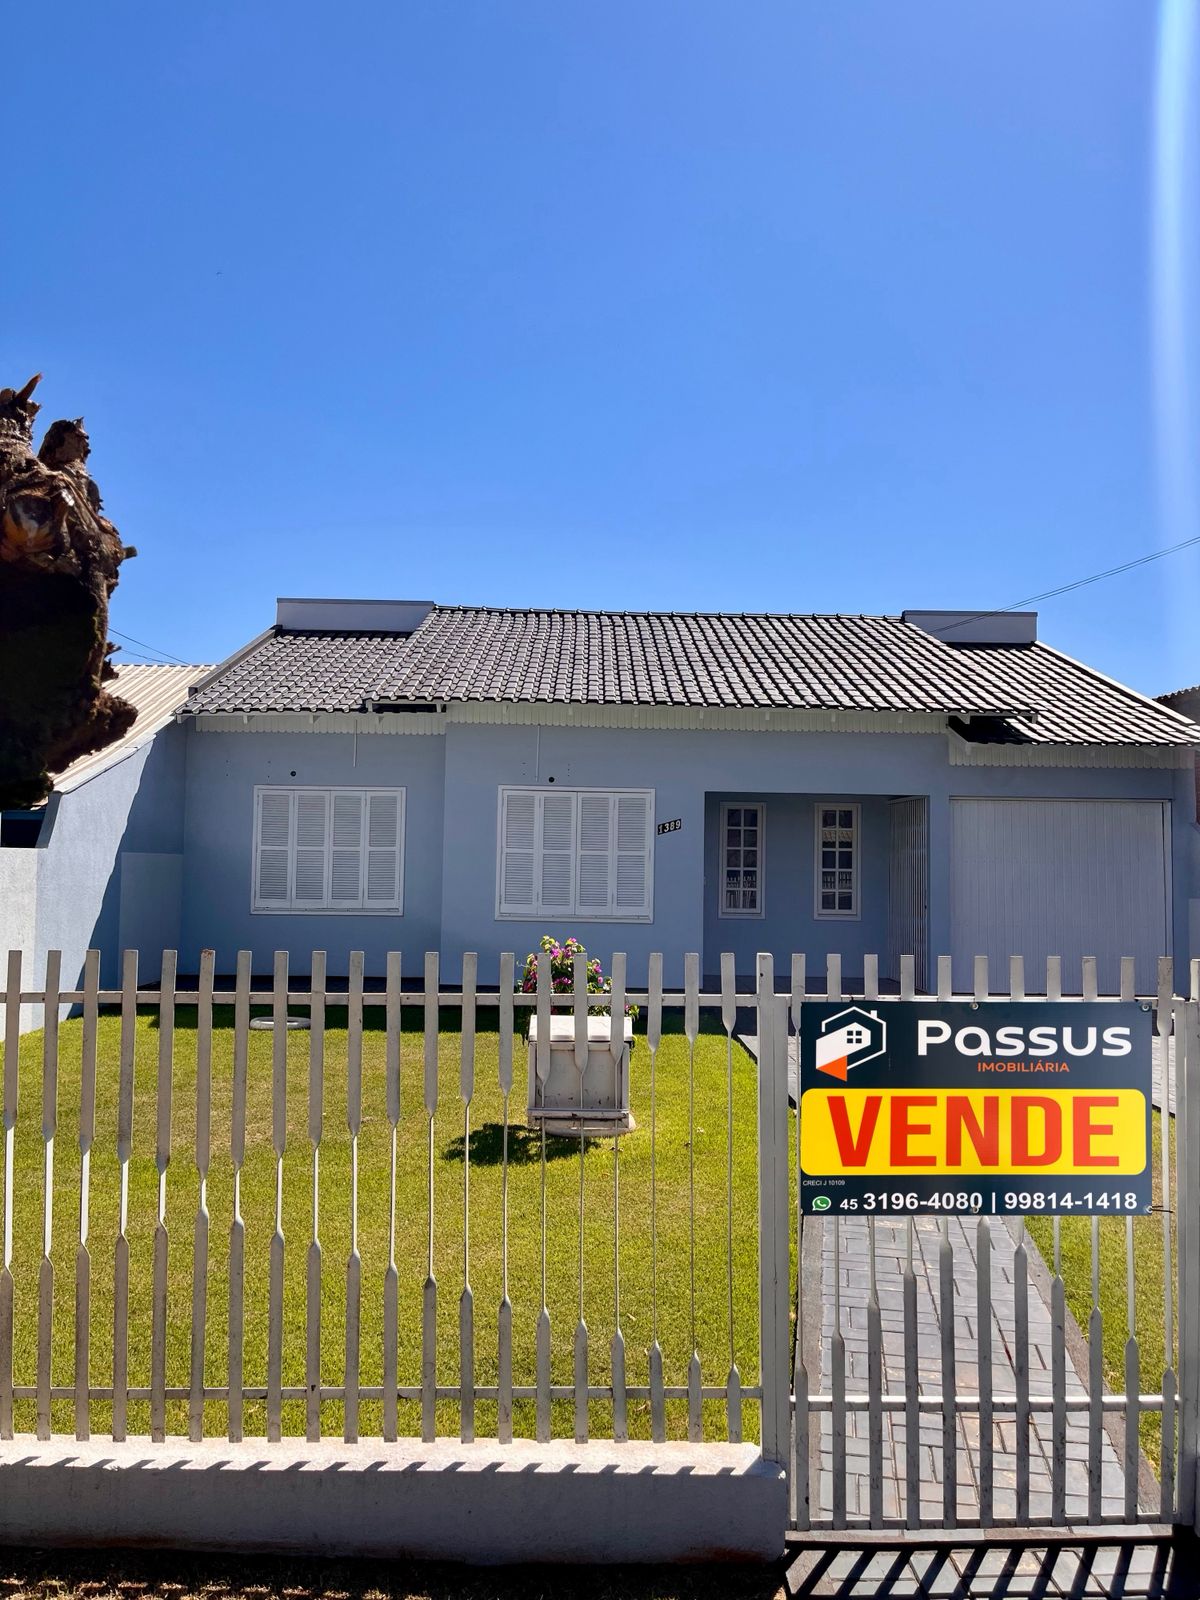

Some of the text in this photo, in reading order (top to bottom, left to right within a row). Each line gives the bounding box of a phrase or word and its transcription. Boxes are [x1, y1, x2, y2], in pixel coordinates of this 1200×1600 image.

[658, 820, 681, 834] 1389
[917, 1019, 1132, 1057] Passus
[977, 1060, 1070, 1073] IMOBILIÁRIA
[826, 1096, 1120, 1167] VENDE
[840, 1199, 858, 1210] 45
[863, 1192, 983, 1210] 3196-4080
[1004, 1192, 1138, 1210] 99814-1418
